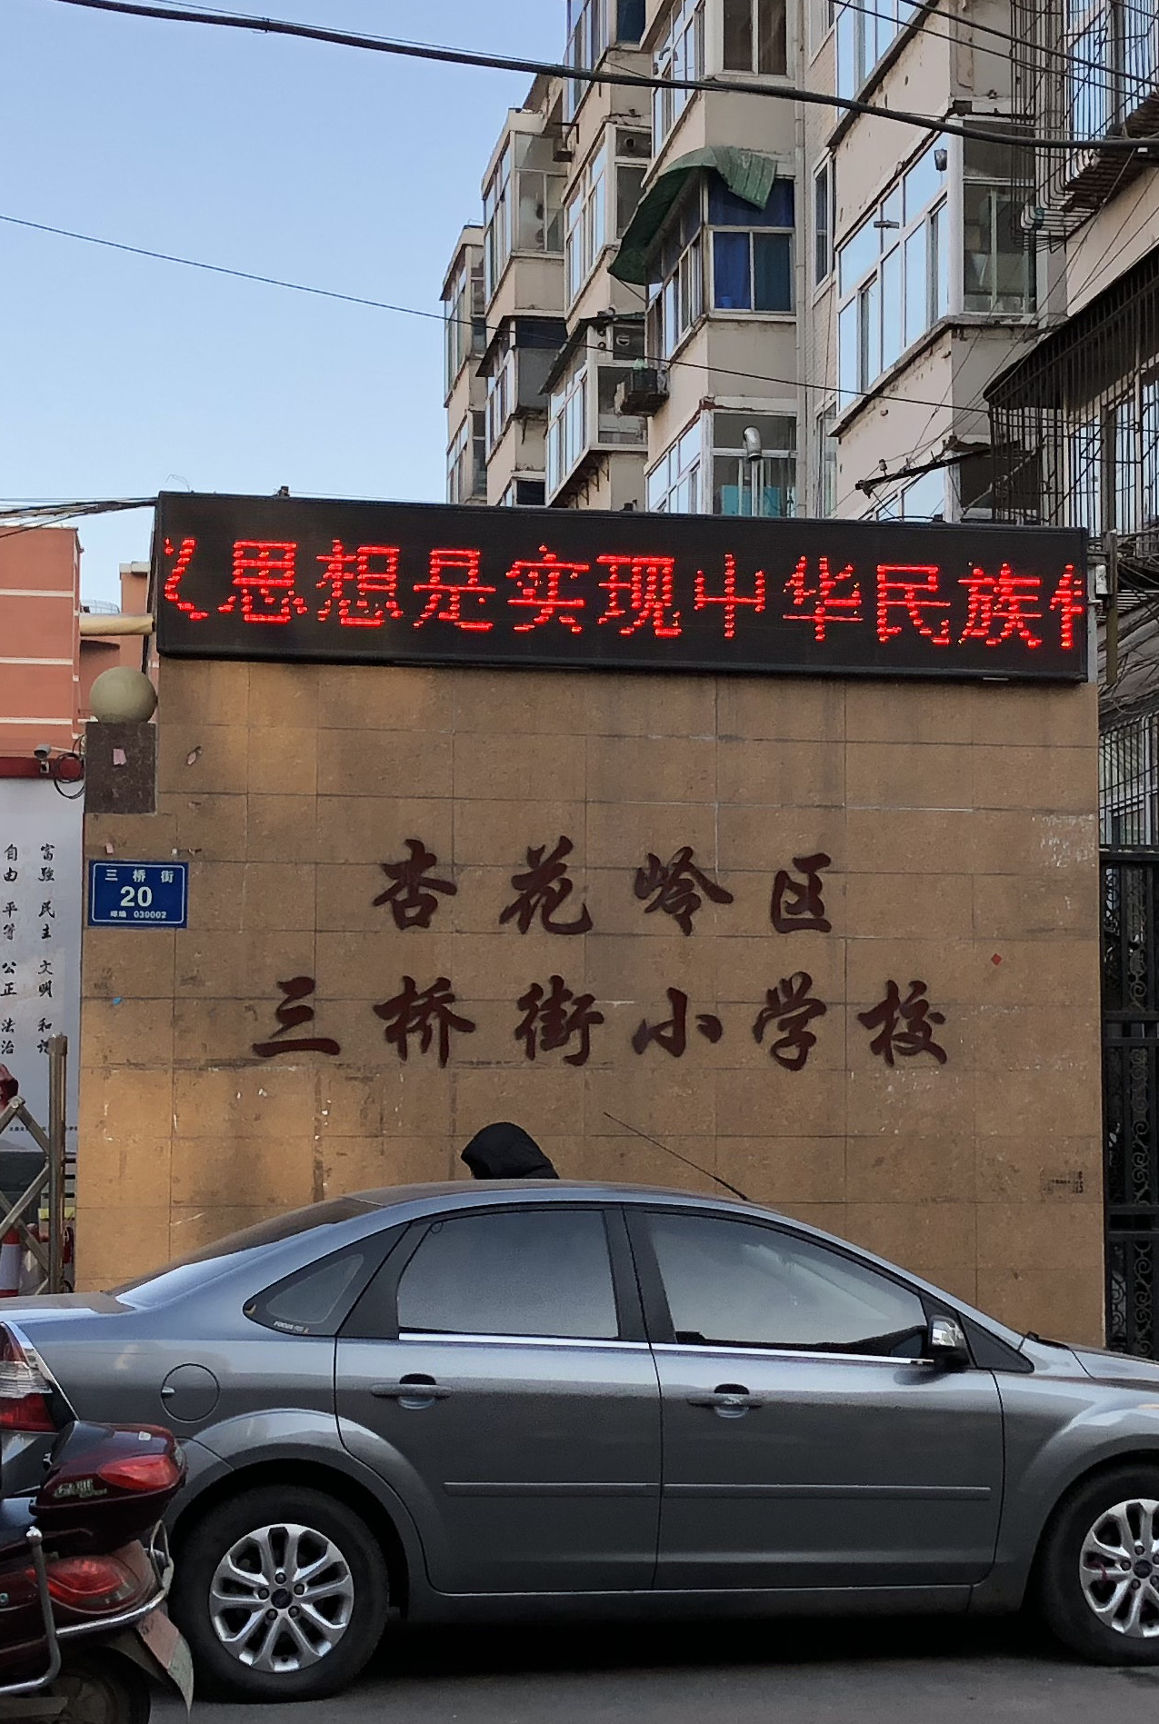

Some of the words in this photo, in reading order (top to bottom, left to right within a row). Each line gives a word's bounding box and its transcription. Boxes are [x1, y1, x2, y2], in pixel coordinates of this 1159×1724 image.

[2, 843, 18, 882] 自由
[105, 869, 174, 883] 三桥街
[120, 886, 153, 907] 20
[372, 836, 832, 936] 杏花岭区
[2, 901, 18, 940] 平等
[38, 901, 55, 939] 民主
[0, 961, 17, 997] 公正
[37, 960, 54, 998] 文明
[1, 1017, 16, 1055] 法治
[252, 972, 948, 1071] 三桥街小学校
